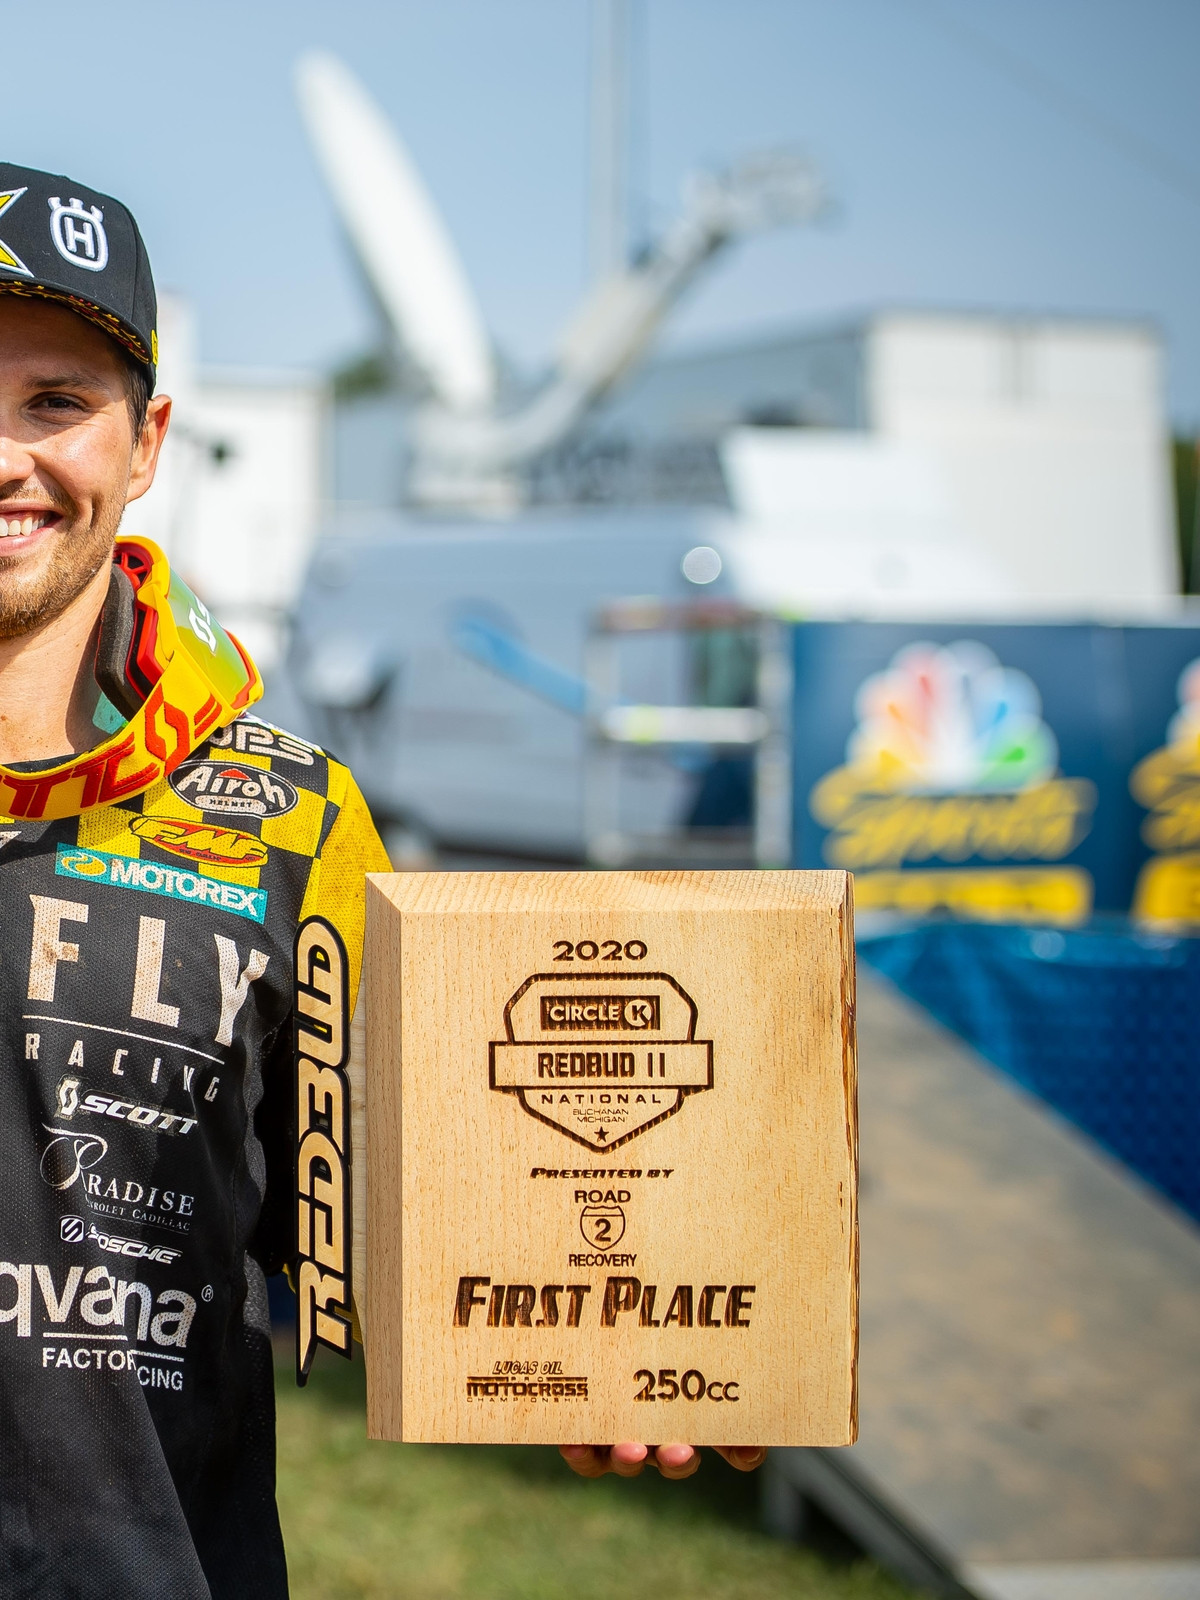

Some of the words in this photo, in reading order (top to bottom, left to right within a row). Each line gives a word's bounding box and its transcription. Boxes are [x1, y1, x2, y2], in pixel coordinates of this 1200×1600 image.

[176, 765, 287, 809] Airoh
[208, 798, 253, 808] HELMET
[132, 818, 269, 860] FMF
[110, 857, 260, 917] MOTOREX
[551, 939, 648, 961] 2020
[26, 893, 271, 1048] FLY
[550, 1004, 620, 1022] CIRCLE
[538, 1052, 636, 1078] REDBUD
[541, 1093, 662, 1105] NATIONAL
[79, 1094, 198, 1135] SCOTT
[572, 1108, 629, 1116] BUCHANAN
[574, 1189, 632, 1204] ROAD
[594, 1217, 612, 1243] 2
[568, 1253, 638, 1268] RECOVERY
[452, 1276, 592, 1329] FIRST
[600, 1276, 756, 1329] PLACE
[136, 1365, 184, 1391] CING
[492, 1360, 539, 1375] LUCAS
[540, 1360, 564, 1375] OIL
[466, 1382, 589, 1397] MOTOCROSS
